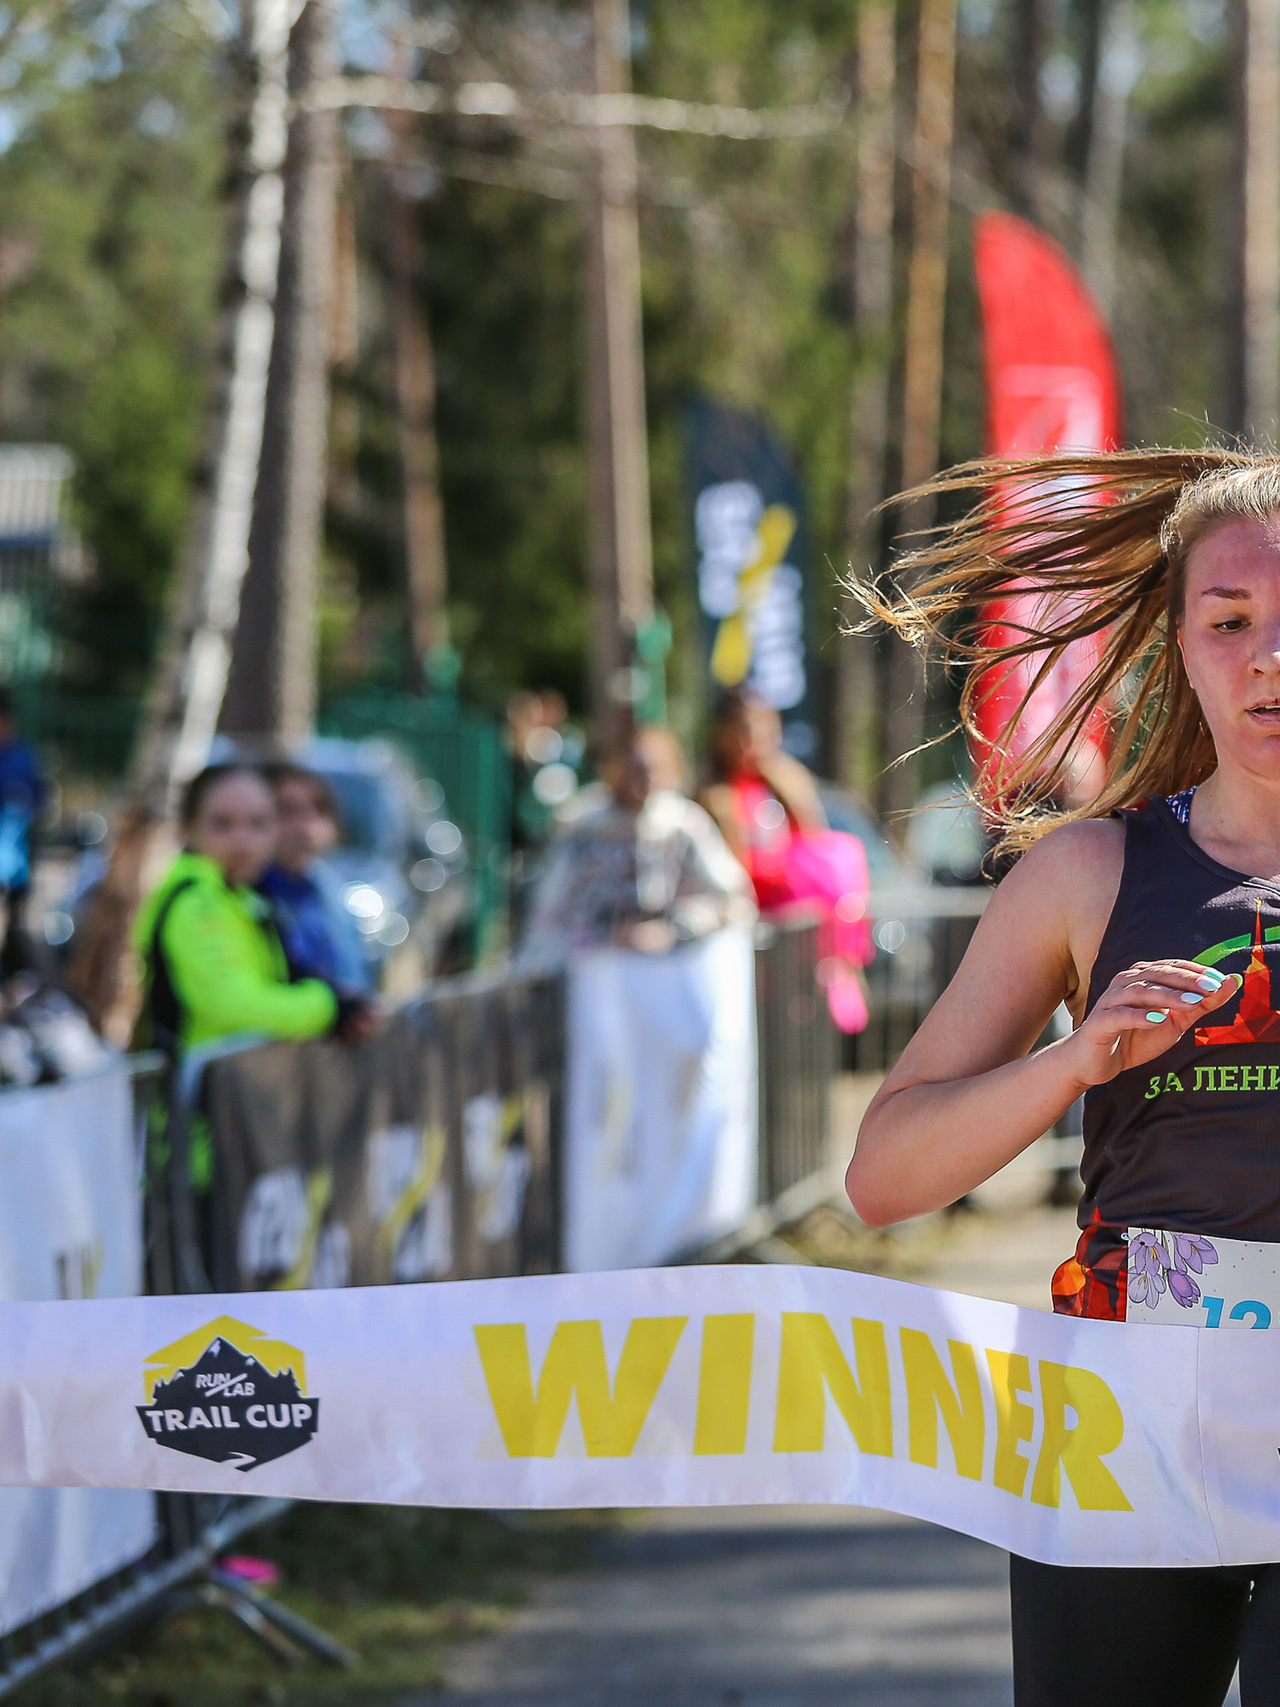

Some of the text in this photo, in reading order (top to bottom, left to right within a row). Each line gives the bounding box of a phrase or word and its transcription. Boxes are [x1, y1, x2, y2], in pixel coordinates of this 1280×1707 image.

[1144, 1072, 1184, 1099] ЗА
[195, 1373, 231, 1389] RUN
[223, 1382, 256, 1397] LAB
[145, 1403, 312, 1432] TRAIL CUP
[472, 1311, 1135, 1512] WINNER
